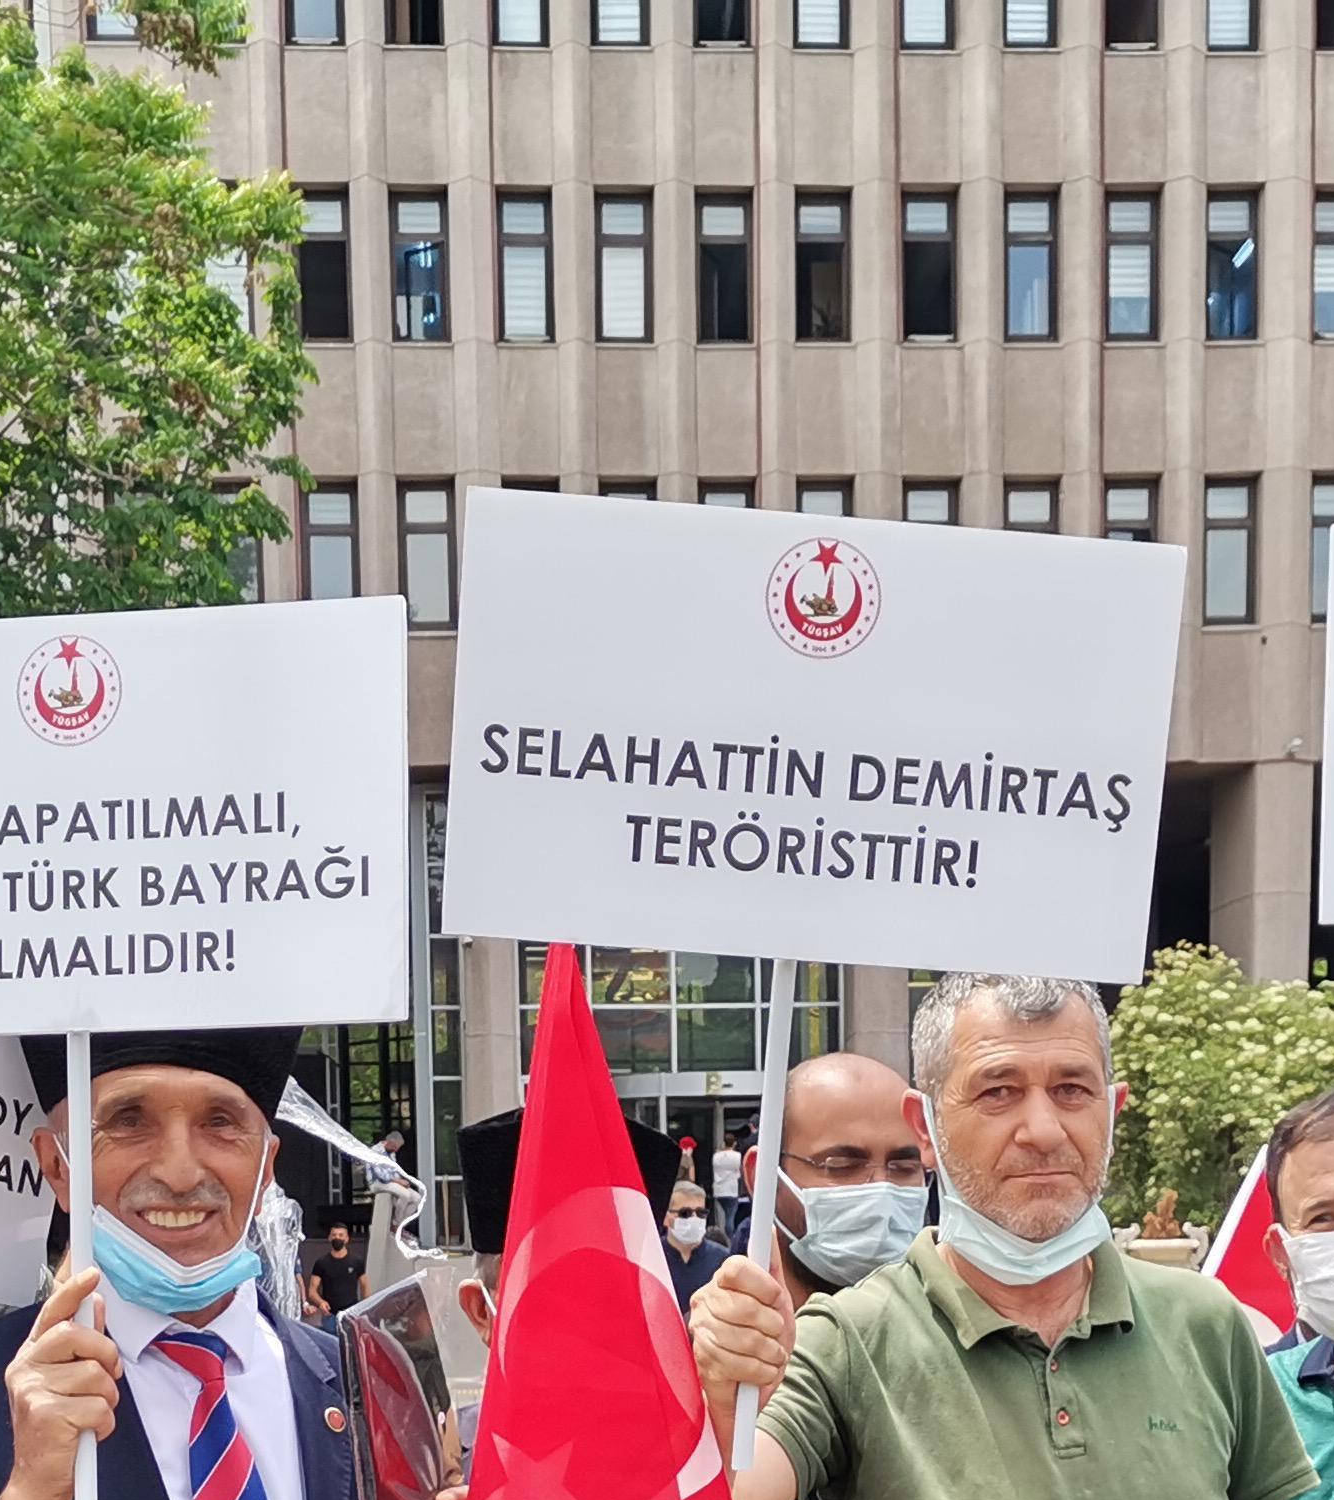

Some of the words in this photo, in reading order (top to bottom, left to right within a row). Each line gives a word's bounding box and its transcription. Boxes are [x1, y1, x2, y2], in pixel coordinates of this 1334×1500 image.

[480, 724, 824, 798] SELAHATTİN
[849, 752, 1132, 833] DEMİRTAŞ
[3, 860, 119, 912] TÜRK
[141, 846, 368, 906] BAYRAĞI
[626, 811, 978, 888] TERÖRİSTTİR!
